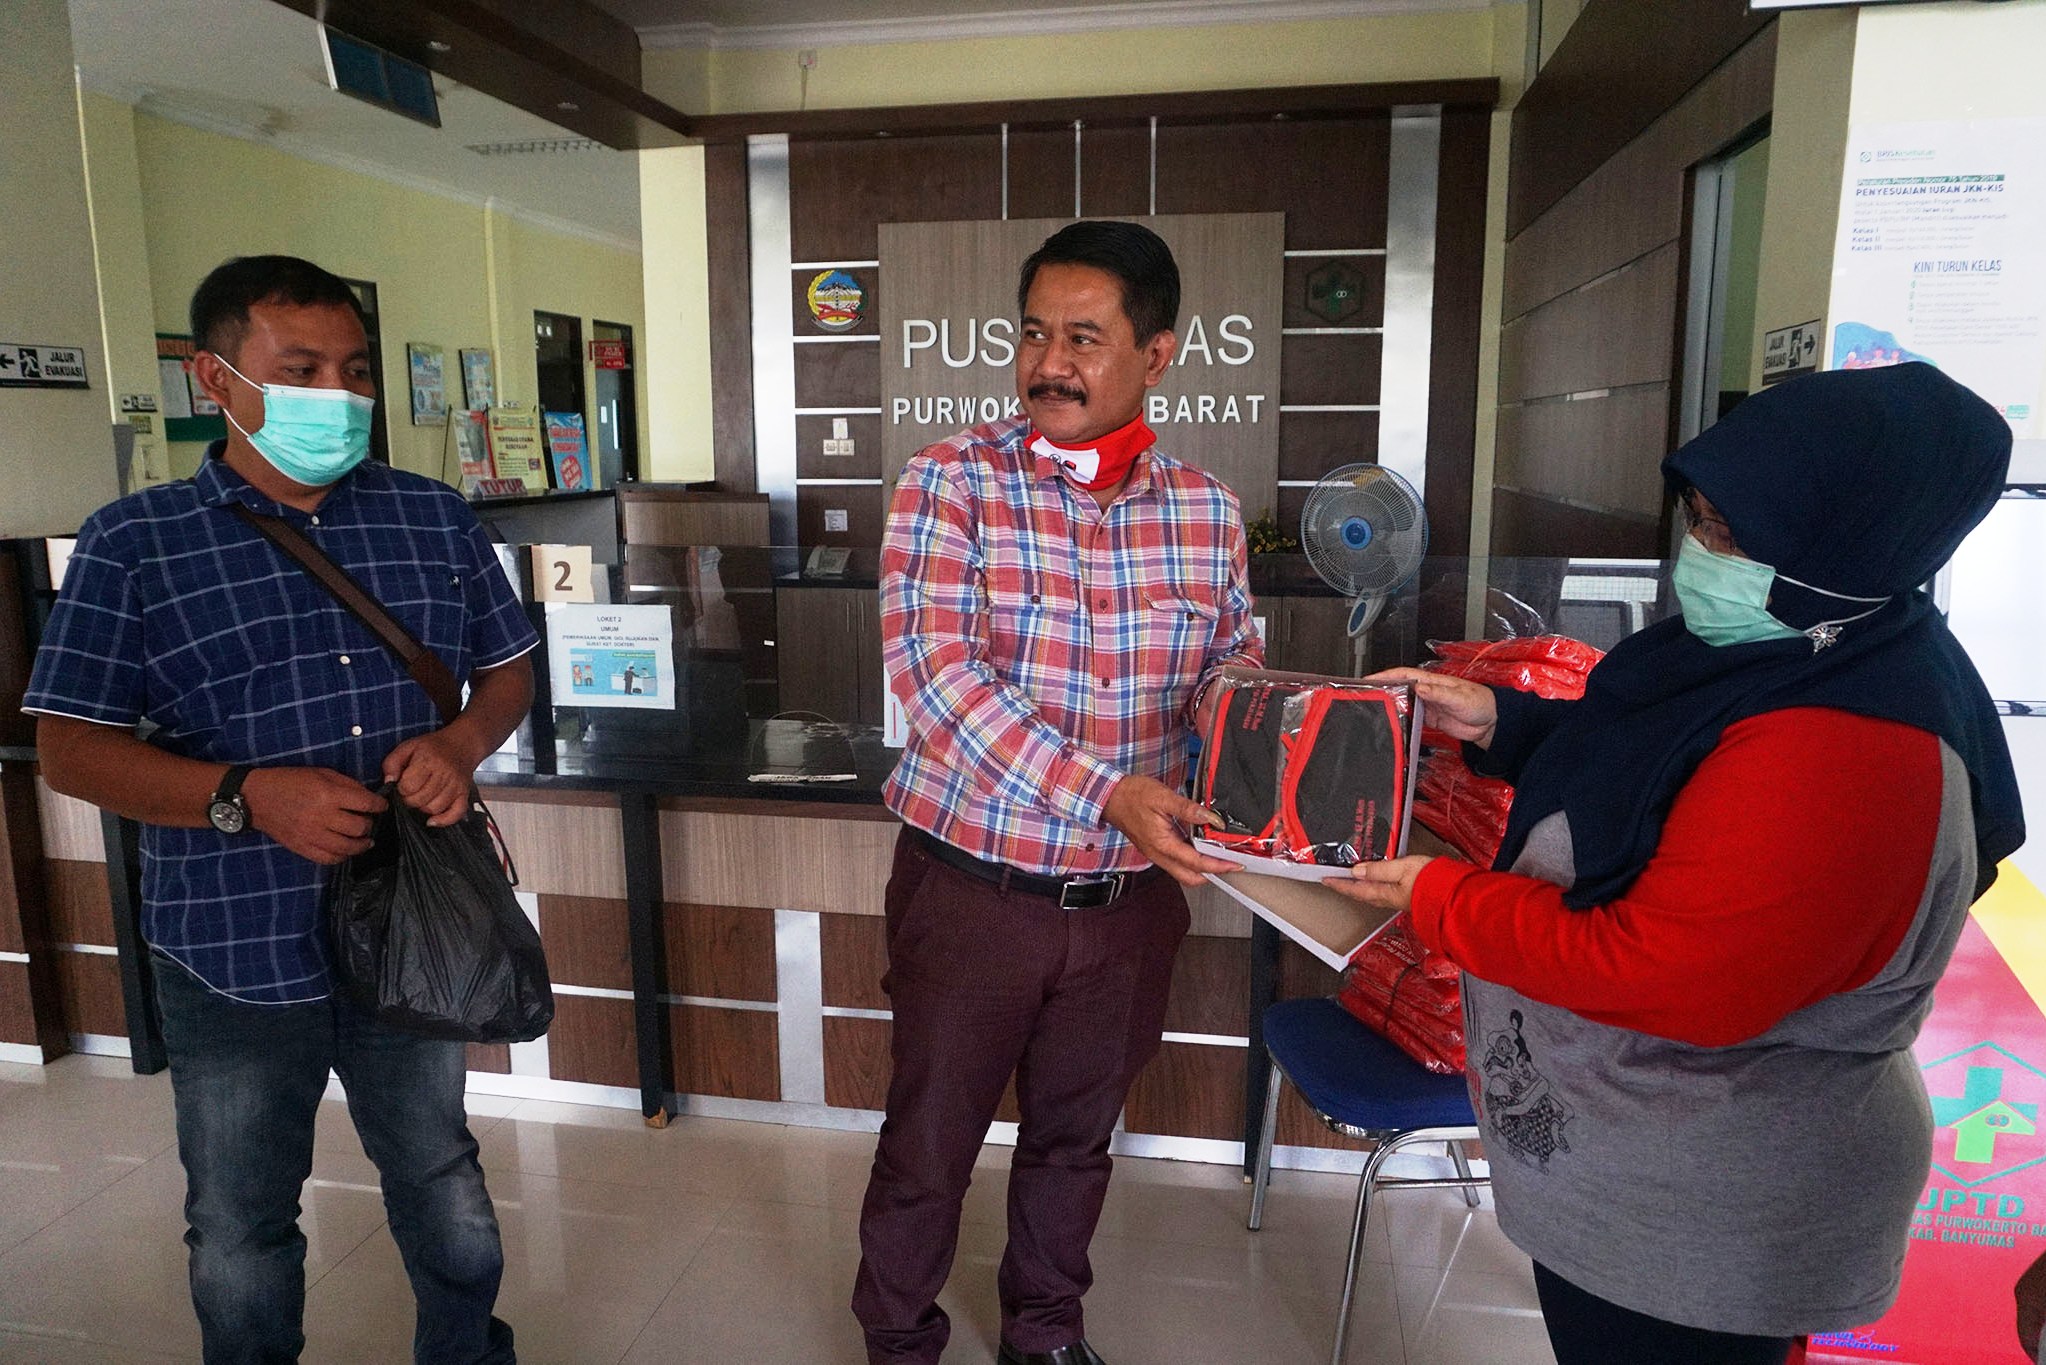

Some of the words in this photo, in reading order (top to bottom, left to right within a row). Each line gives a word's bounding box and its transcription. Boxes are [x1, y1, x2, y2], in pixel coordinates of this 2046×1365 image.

[1856, 186, 1926, 196] PENYESUAIAN
[1929, 186, 1960, 194] IURAN
[1963, 184, 2004, 194] JKN-KIS
[1914, 261, 1934, 273] KINI
[1937, 260, 1969, 272] TURUN
[1971, 259, 2002, 271] KELAS
[50, 351, 76, 363] JALUR
[45, 365, 83, 377] EVAKUASI
[1149, 394, 1265, 424] BARAT
[480, 480, 523, 495] TUTUP
[553, 561, 573, 592] 2
[1936, 1215, 2027, 1235] PURWOKERTO
[1908, 1227, 1937, 1240] KAB.
[1941, 1229, 2015, 1248] BANYUMAS
